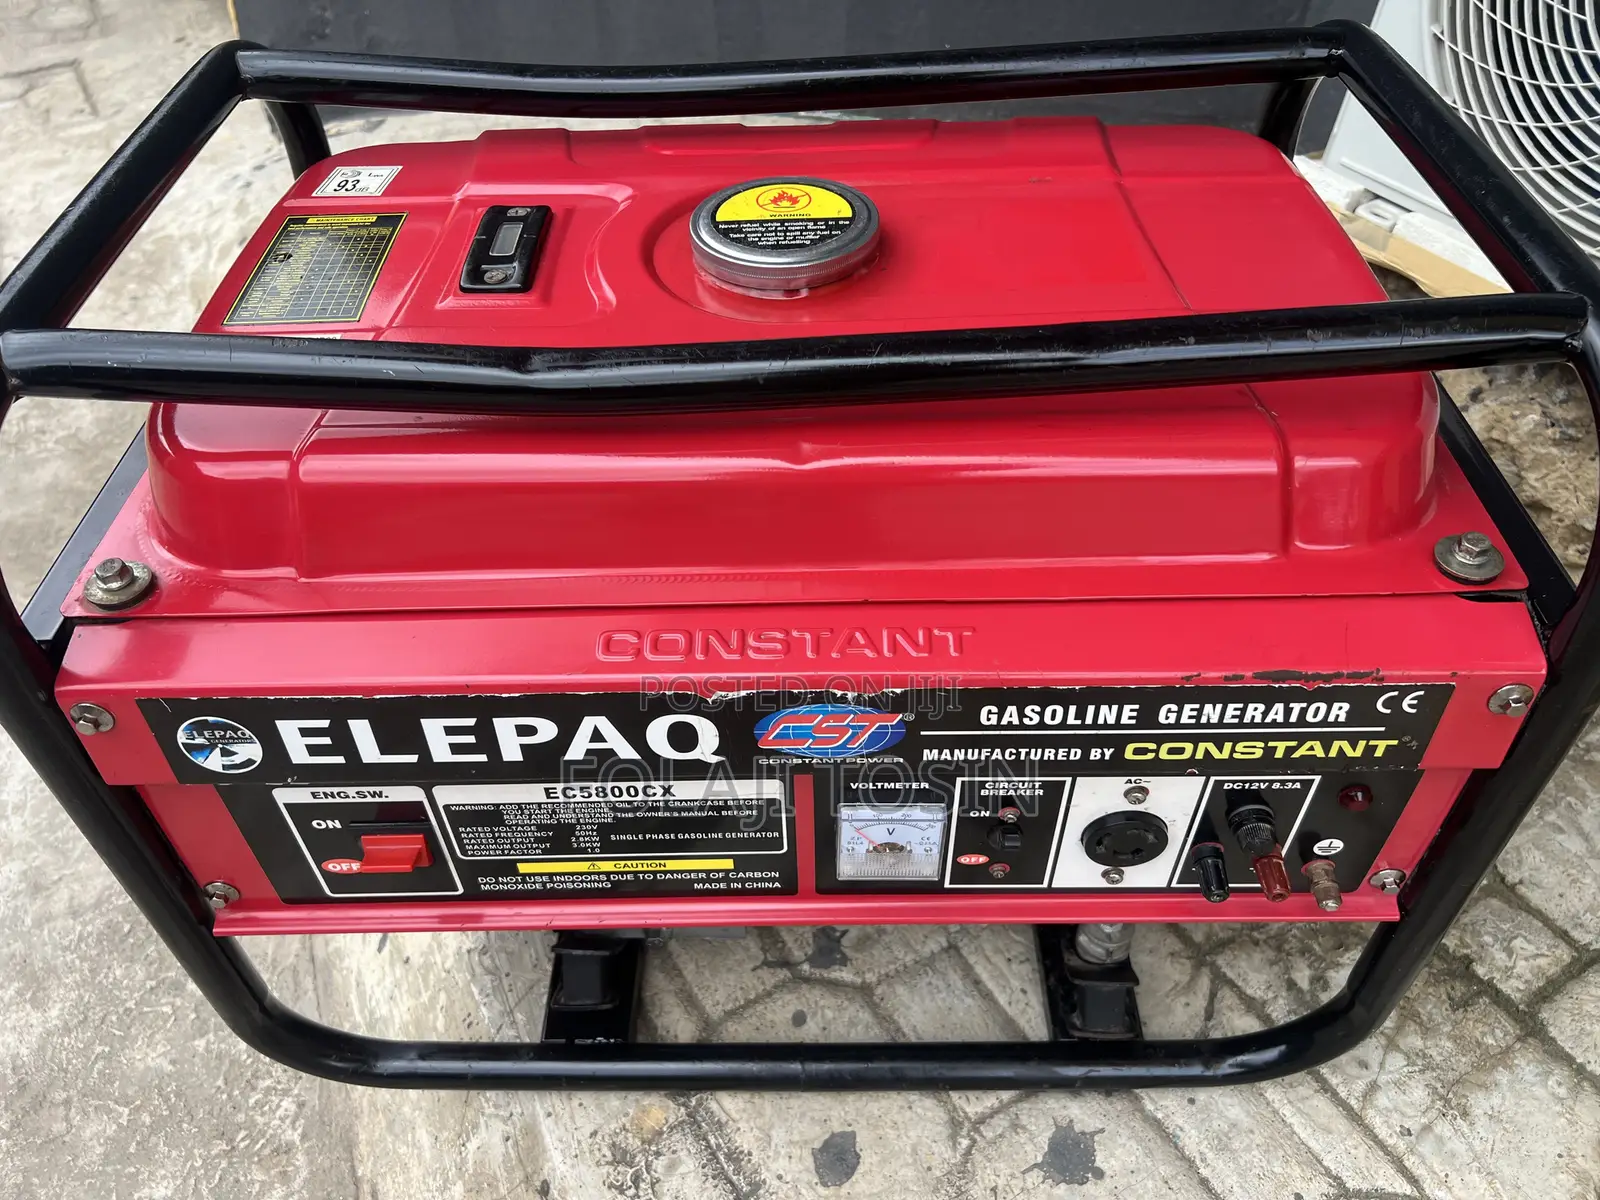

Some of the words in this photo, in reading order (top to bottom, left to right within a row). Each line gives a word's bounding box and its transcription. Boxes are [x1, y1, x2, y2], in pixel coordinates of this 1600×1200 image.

[333, 179, 360, 192] 93
[595, 626, 976, 662] CONSTANT
[979, 704, 1140, 726] GASOLINE
[1158, 702, 1351, 725] GENERATOR
[184, 729, 252, 740] ELEPAQ
[757, 712, 903, 749] CST
[274, 713, 726, 765] ELEPAQ
[922, 748, 1083, 762] MANUFACTURED
[1088, 748, 1115, 761] BY
[1124, 739, 1399, 761] CONSTANT
[758, 757, 844, 765] CONSTANT
[850, 782, 930, 790] VOLTMETER
[984, 781, 1042, 789] CIRCUIT
[1223, 782, 1270, 790] DC12V
[1271, 781, 1302, 789] 8.3A
[310, 790, 389, 801] ENG.SW.
[543, 785, 677, 800] EC5800CX
[980, 789, 1044, 797] BREAKER
[969, 810, 990, 818] ON
[311, 818, 343, 830] ON
[677, 832, 723, 840] GASOLINE
[725, 831, 780, 839] GENERATOR
[887, 828, 896, 836] V
[614, 861, 667, 869] CAUTION
[960, 856, 982, 864] OFF
[327, 861, 361, 873] OFF
[478, 876, 496, 884] DO
[498, 875, 523, 884] NOT
[525, 875, 551, 883] USE
[553, 874, 607, 882] INDOORS
[610, 873, 635, 881] DUE
[637, 872, 654, 880] TO
[656, 872, 708, 880] DANGER
[709, 871, 726, 879] OF
[728, 871, 780, 879] CARBON
[480, 882, 544, 891] MONOXIDE
[548, 881, 612, 890] POISONING
[693, 882, 727, 890] MADE
[730, 881, 742, 889] IN
[744, 881, 782, 889] CHINA
